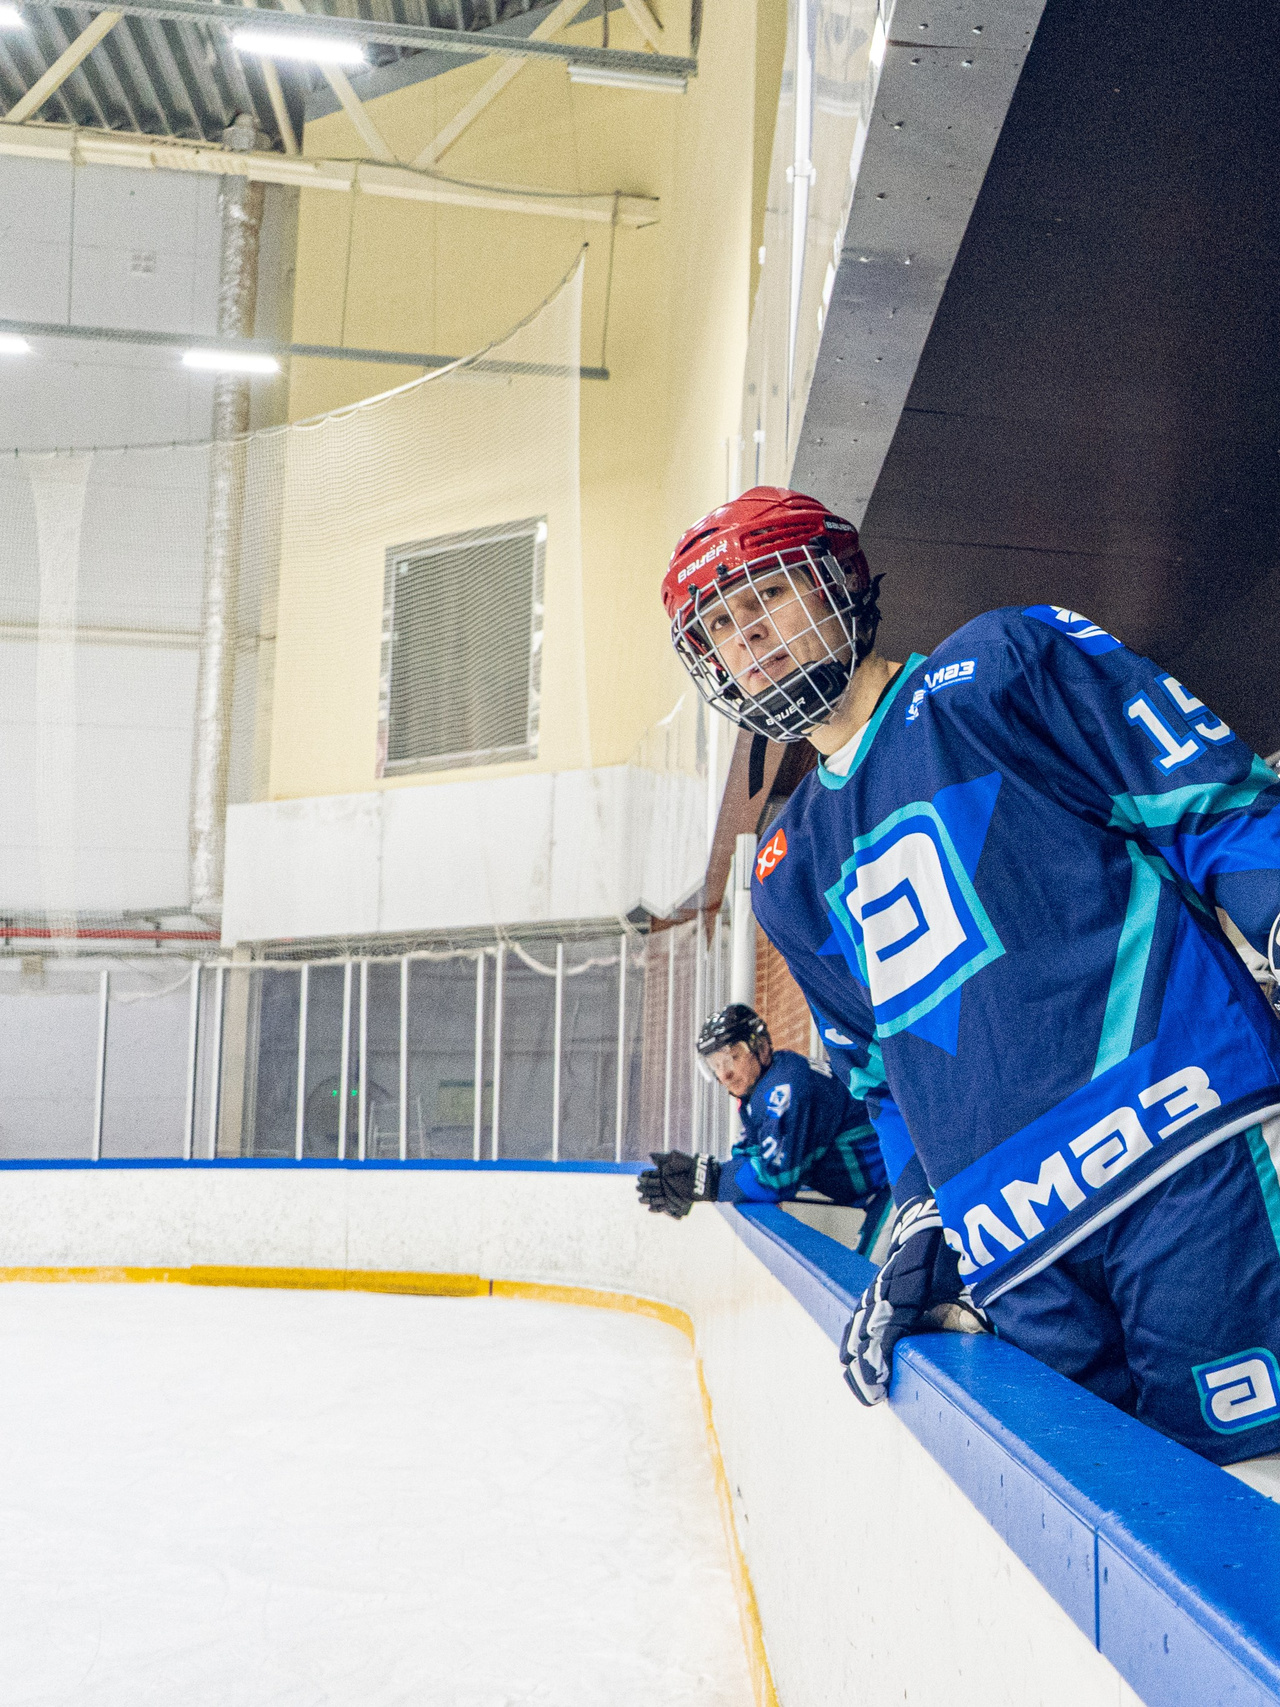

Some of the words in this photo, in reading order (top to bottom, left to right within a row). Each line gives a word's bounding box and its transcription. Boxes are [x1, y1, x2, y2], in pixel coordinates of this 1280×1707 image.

[677, 539, 729, 584] BAUER
[765, 696, 806, 726] BAUER
[1127, 675, 1232, 770] 15
